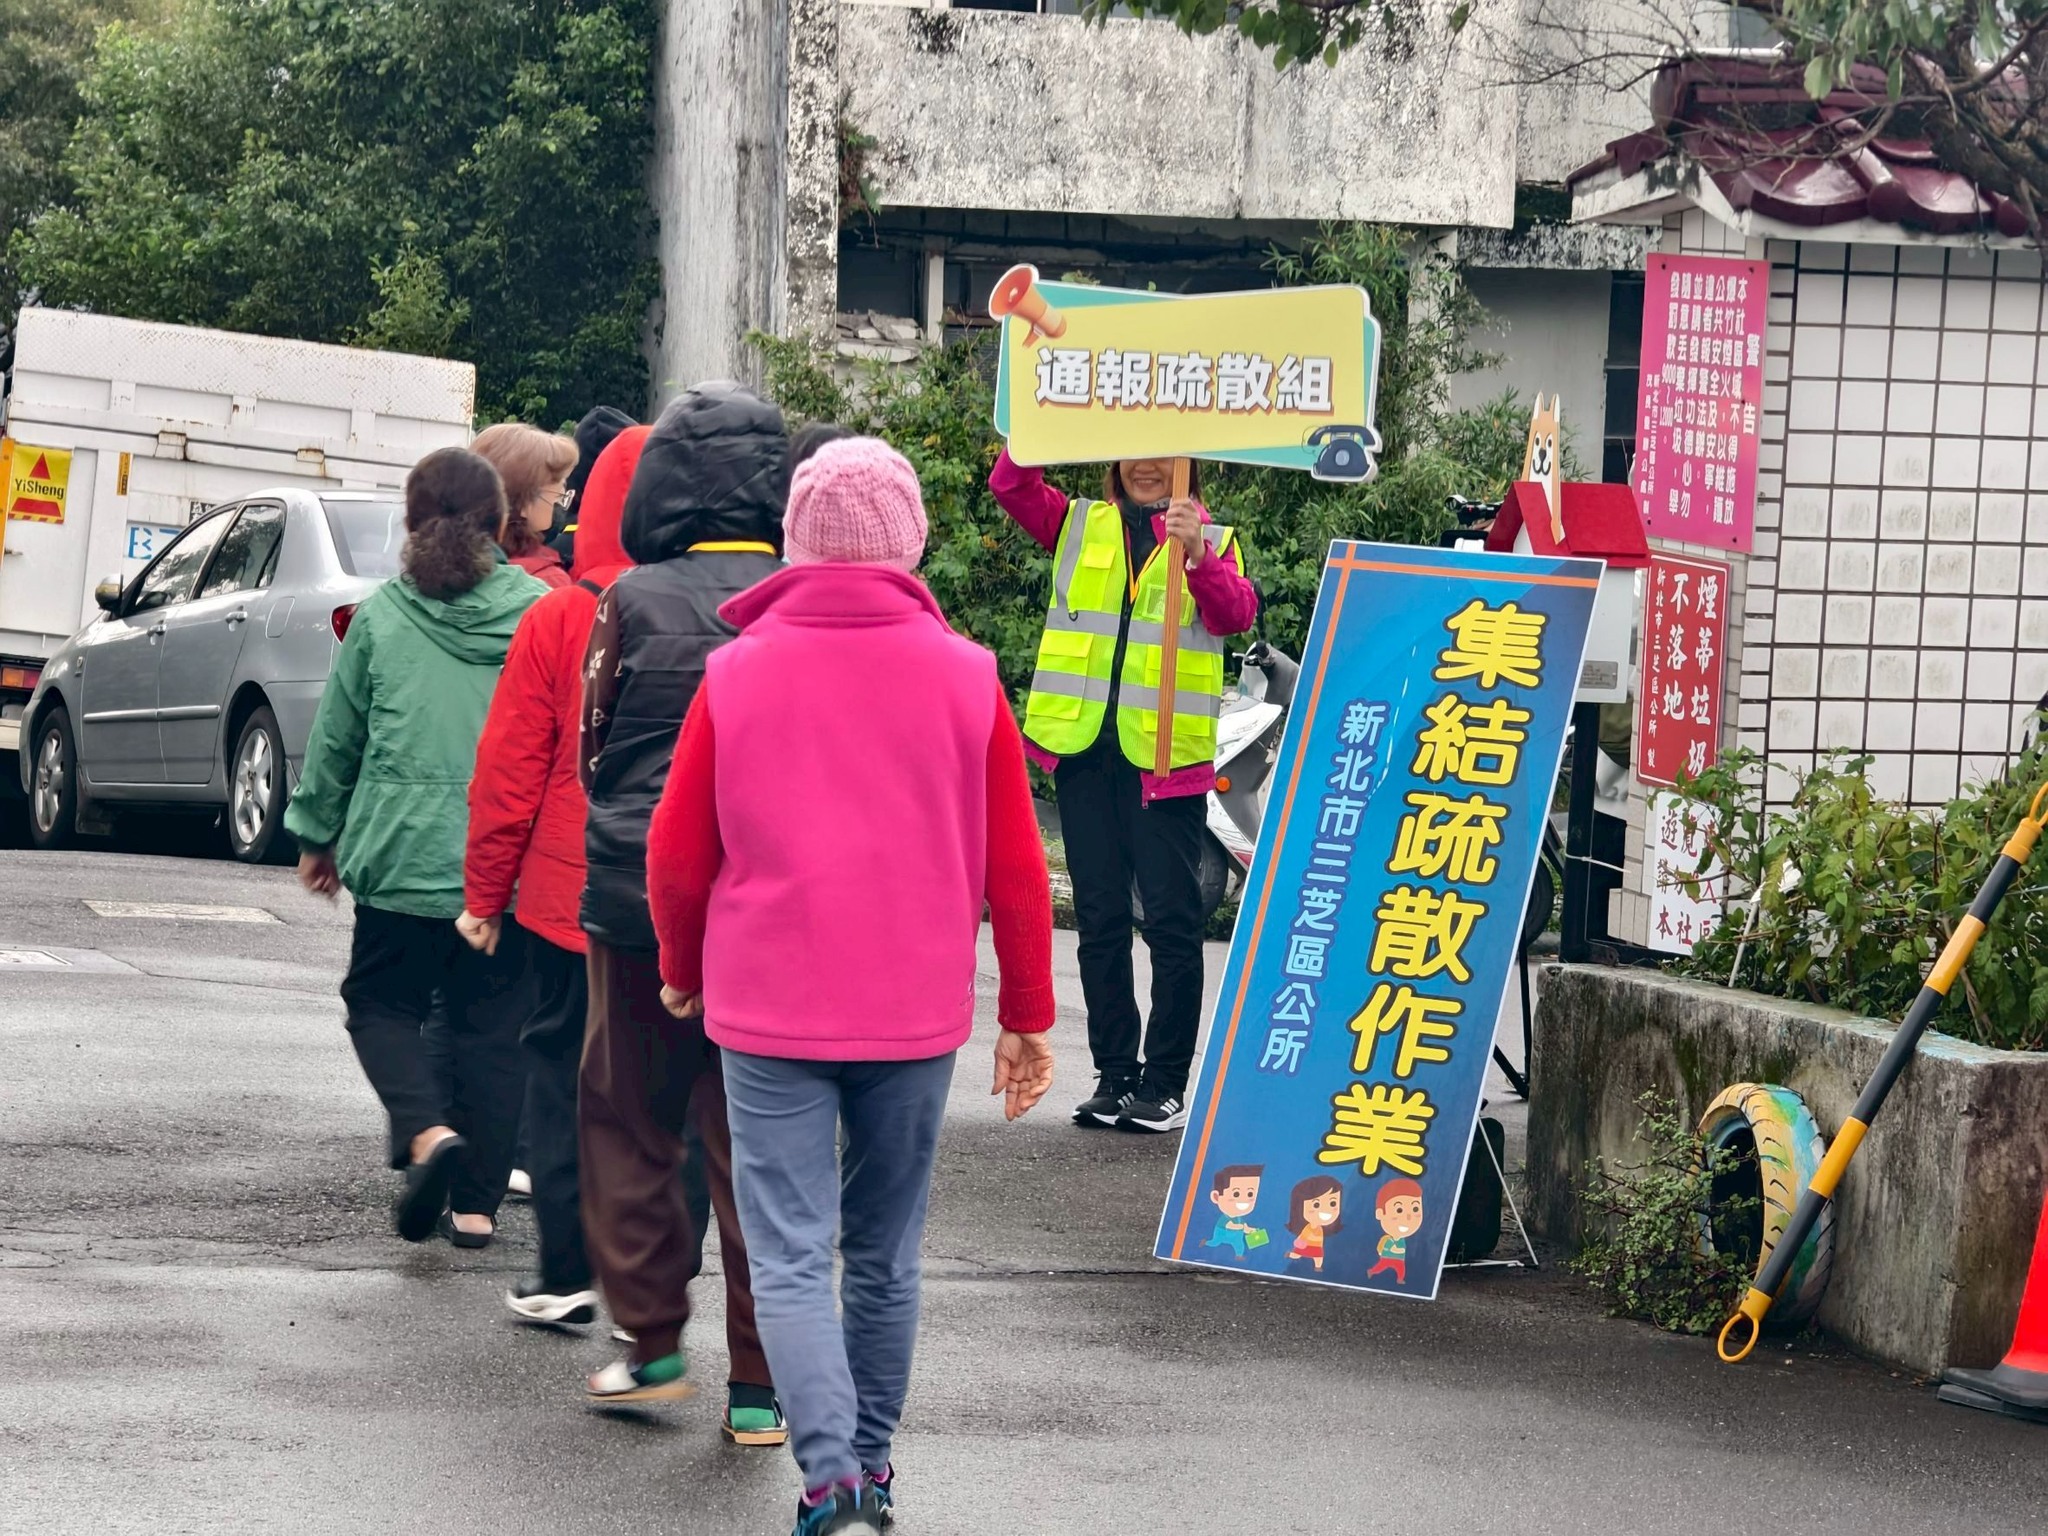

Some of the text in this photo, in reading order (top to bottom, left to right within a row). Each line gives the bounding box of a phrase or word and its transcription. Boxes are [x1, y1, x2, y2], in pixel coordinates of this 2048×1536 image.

[1035, 346, 1334, 413] 通報疏散組
[1647, 374, 1661, 494] 新北市三芝區公所
[1723, 277, 1748, 526] 本社區域不得施放
[1742, 333, 1760, 436] 警告
[15, 479, 65, 501] YiSheng
[1662, 572, 1690, 723] 不落地
[1687, 574, 1719, 777] 煙蒂垃圾
[1259, 702, 1387, 1074] 新北市三芝區公所
[1317, 600, 1548, 1178] 集結疏散作業
